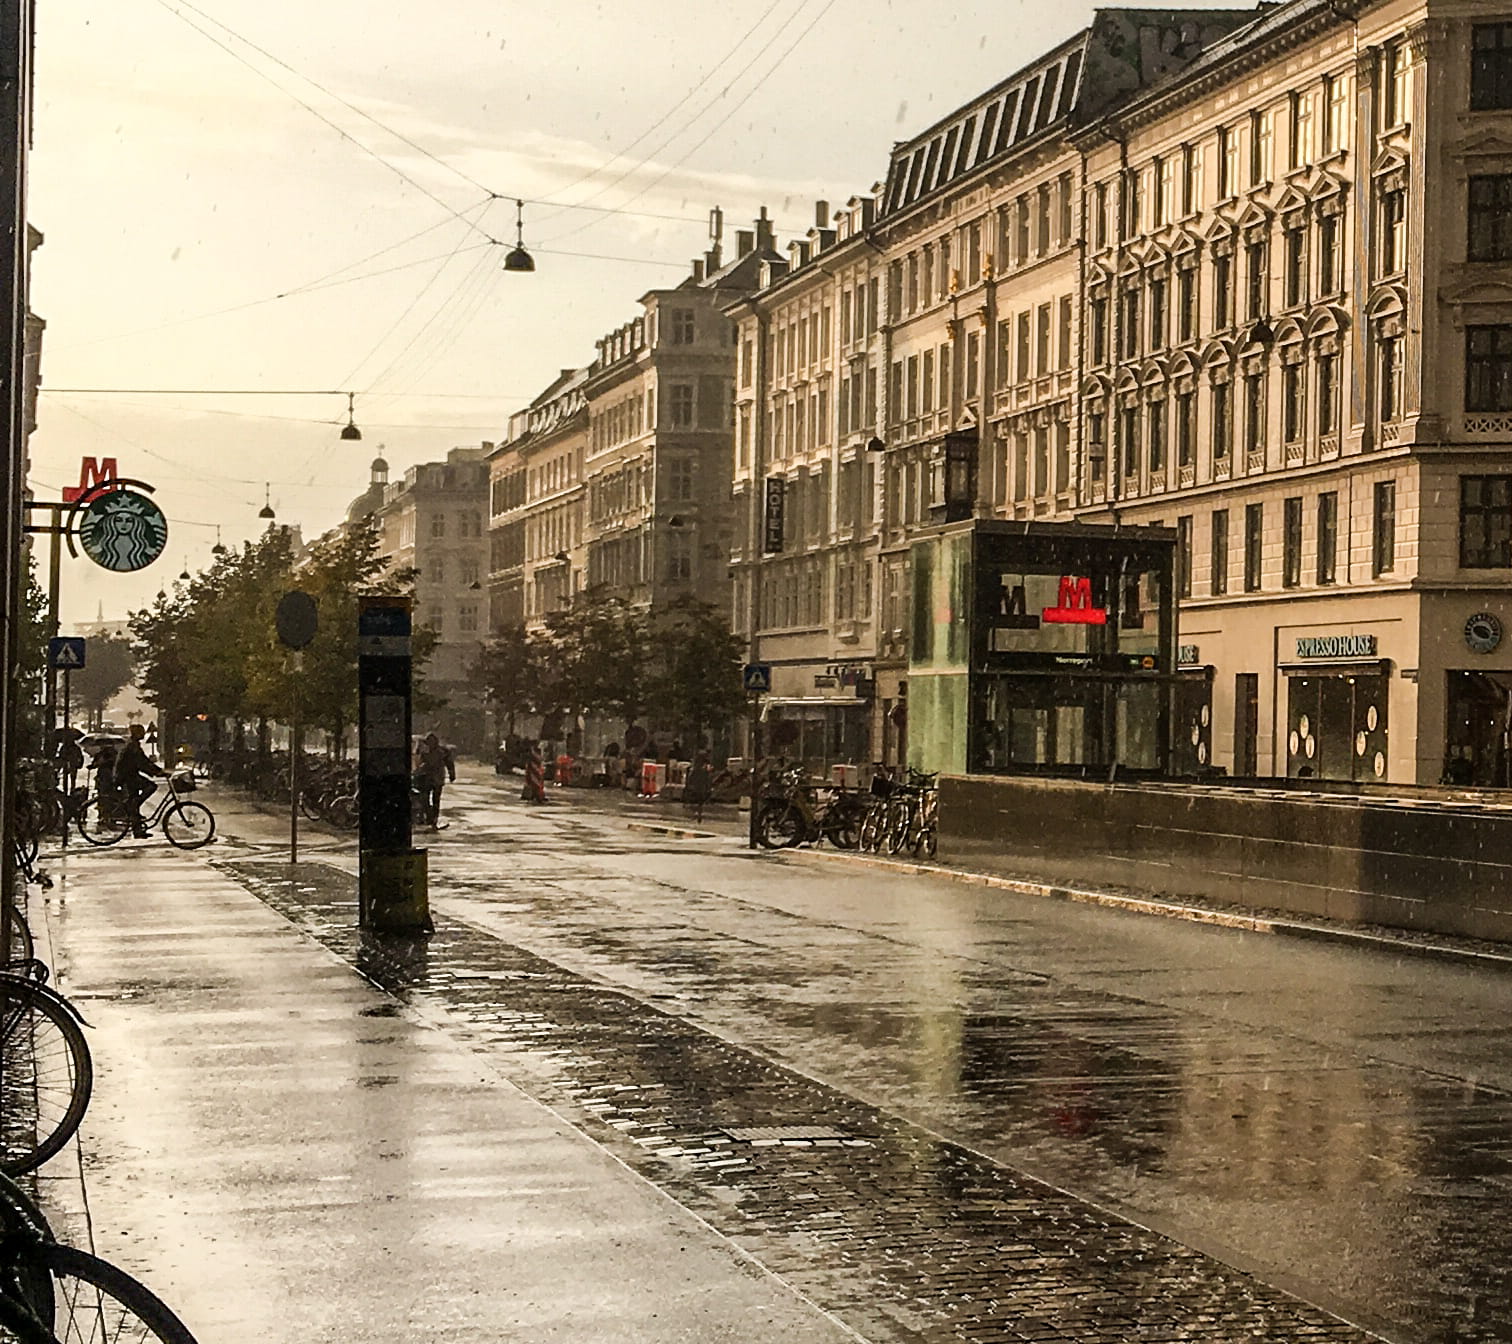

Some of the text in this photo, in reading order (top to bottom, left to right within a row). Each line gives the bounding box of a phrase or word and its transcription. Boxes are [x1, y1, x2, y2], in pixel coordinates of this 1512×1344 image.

[768, 481, 781, 543] HOTEL
[1296, 634, 1372, 657] ESPRESSO HOUSE
